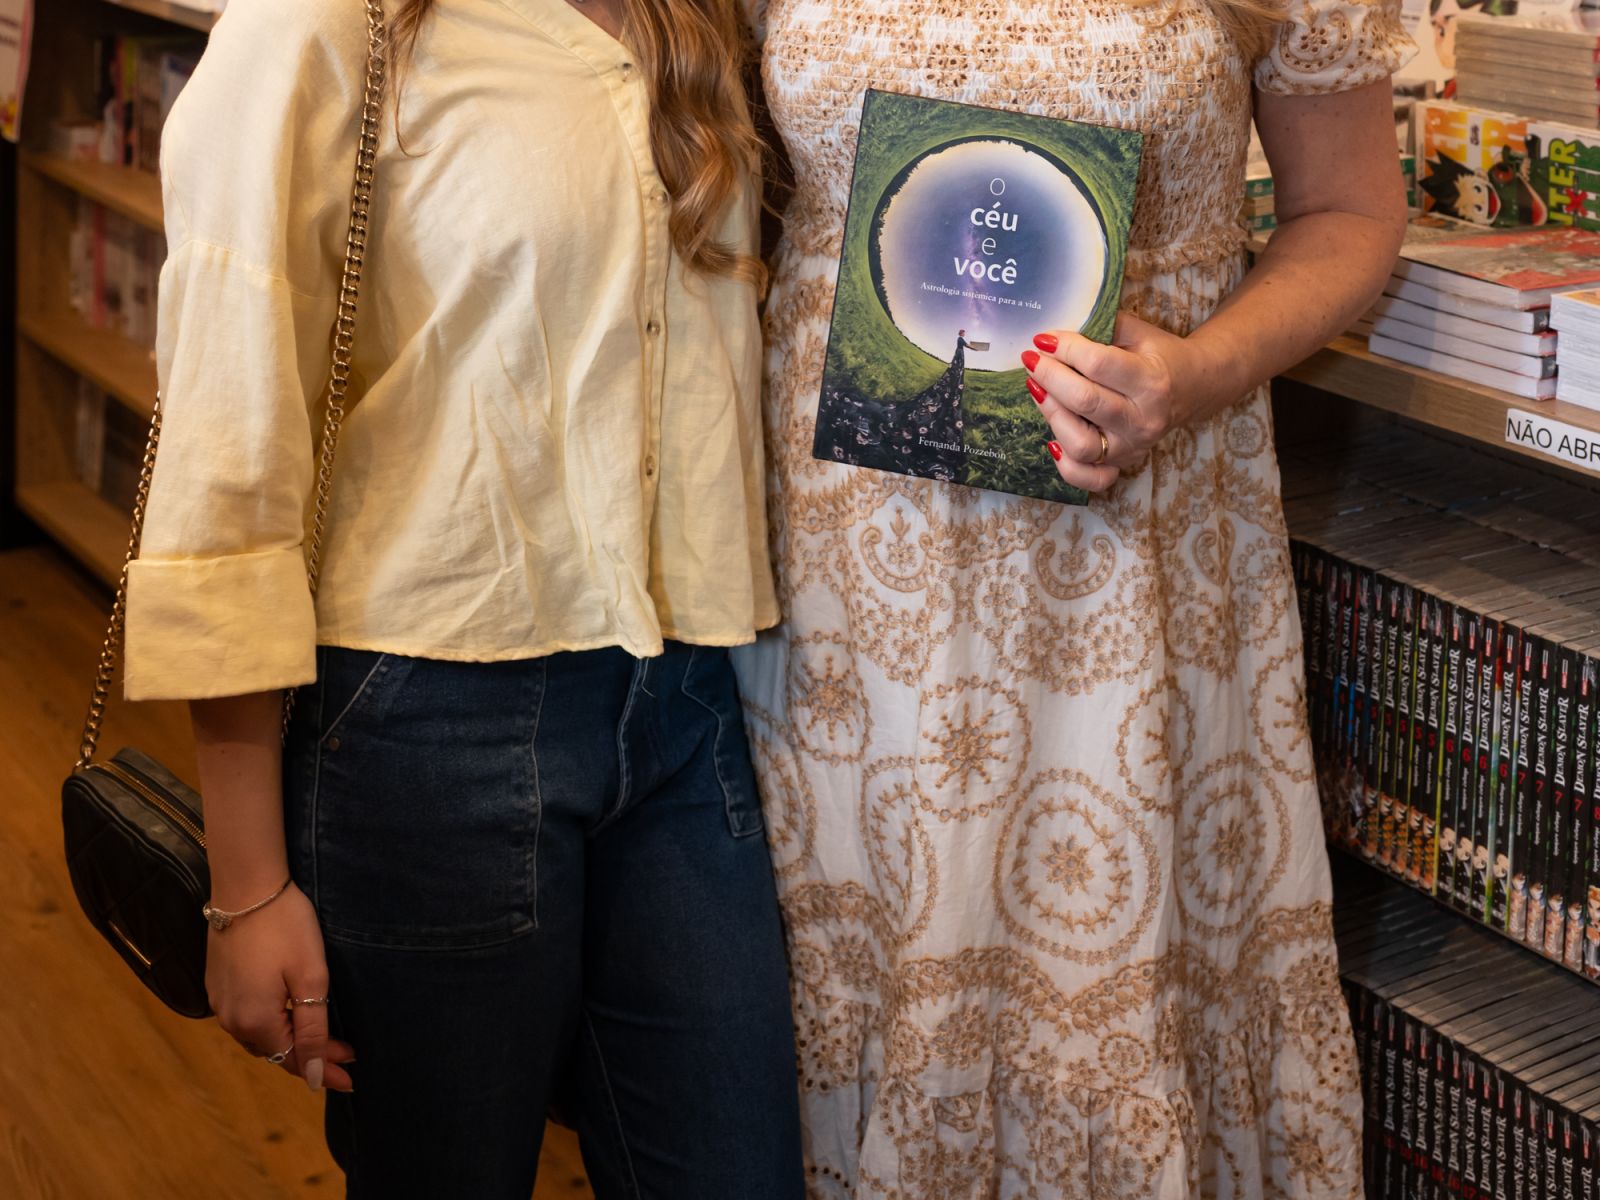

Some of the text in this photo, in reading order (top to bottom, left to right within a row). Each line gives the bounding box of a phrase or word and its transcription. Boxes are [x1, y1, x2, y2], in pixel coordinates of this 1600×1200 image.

[990, 177, 1006, 196] O
[970, 201, 1019, 232] céu
[981, 237, 997, 256] e
[953, 257, 1018, 285] você
[920, 281, 961, 297] Astrologia
[998, 295, 1016, 306] para
[1025, 299, 1042, 310] vida
[919, 436, 1007, 461] Fernanda Pozzebon
[1507, 417, 1600, 462] NÃO ABR
[1446, 649, 1460, 735] DEMON SLAYER
[1463, 657, 1476, 744] DEMON SLAYER
[1479, 664, 1493, 752] DEMON SLAYER
[1500, 671, 1514, 760] DEMON SLAYER
[1518, 679, 1532, 768] DEMON SLAYER
[1535, 687, 1549, 776] DEMON SLAYER
[1554, 697, 1569, 786] DEMON SLAYER
[1574, 704, 1589, 794] DEMON SLAYER
[1518, 771, 1526, 784] 7
[1536, 780, 1544, 792] 7
[1555, 790, 1564, 804] 7
[1575, 799, 1583, 811] 7
